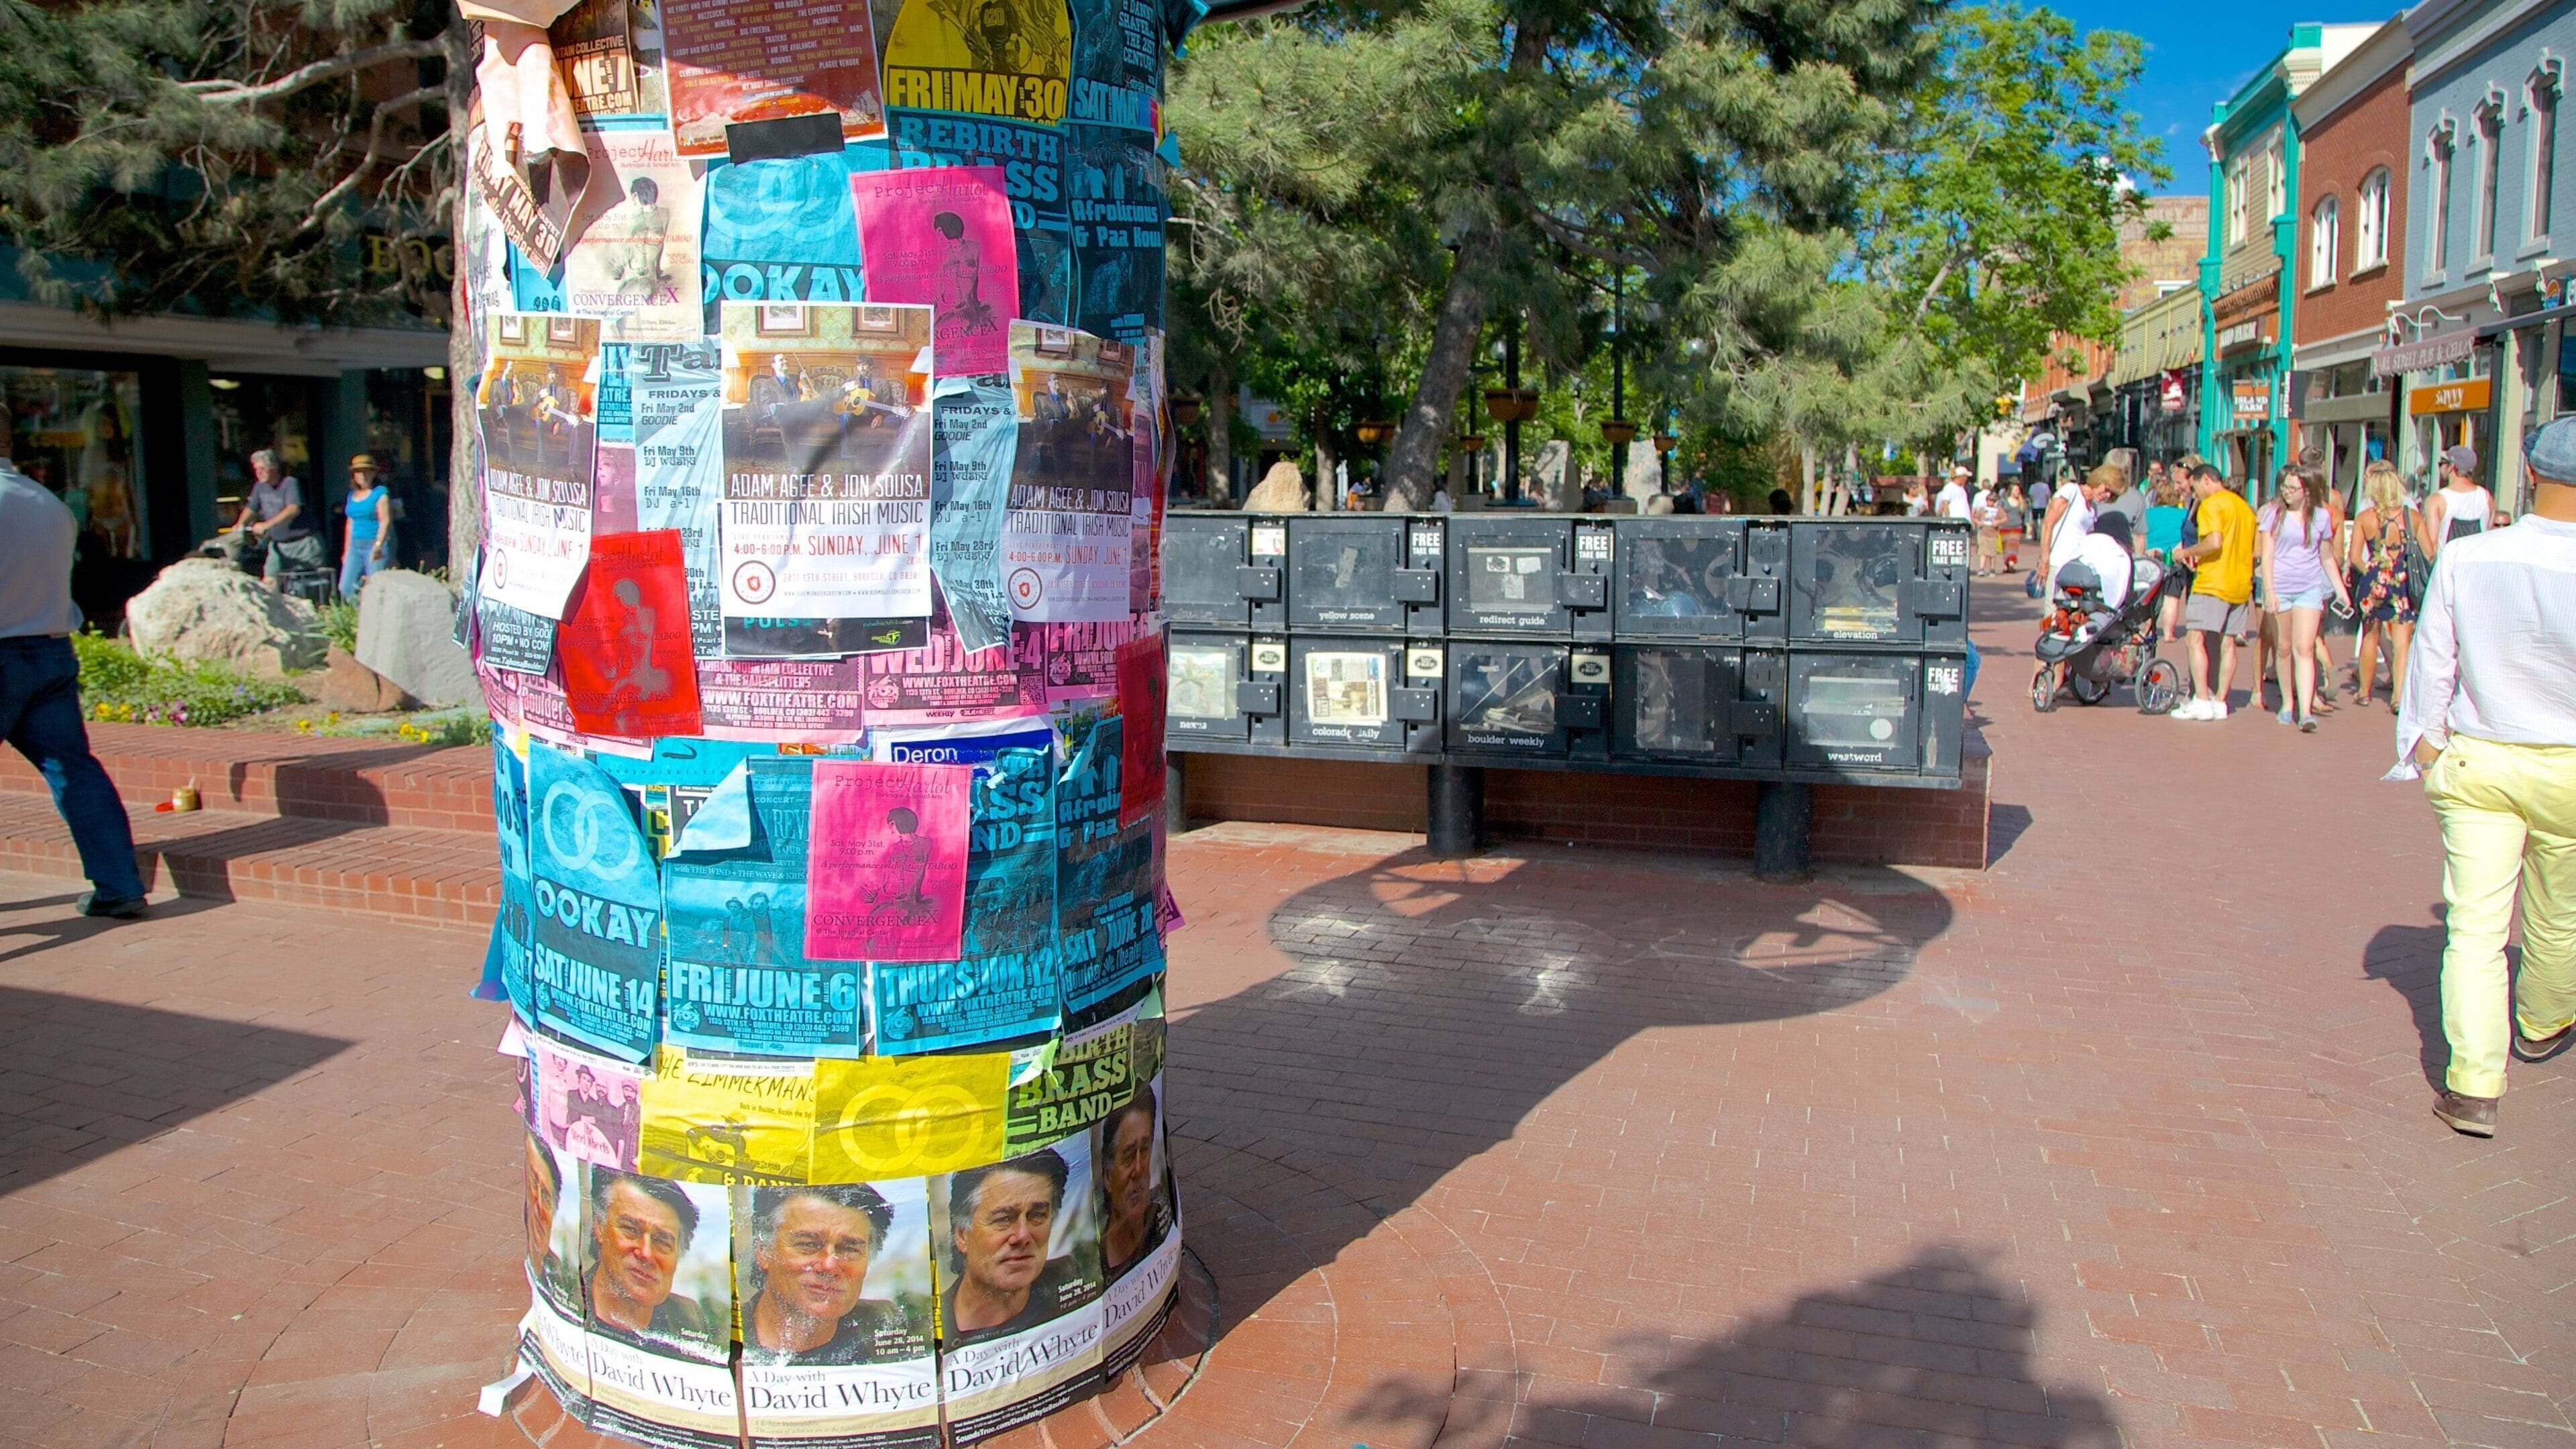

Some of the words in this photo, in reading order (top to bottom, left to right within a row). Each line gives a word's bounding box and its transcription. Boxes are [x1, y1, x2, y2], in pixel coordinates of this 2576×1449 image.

[808, 4, 843, 15] EXPENDABLES
[714, 18, 736, 28] MINERAL
[780, 75, 804, 85] ELECTRIC
[889, 68, 942, 110] FRI
[951, 70, 1019, 116] MAY
[1024, 76, 1064, 119] 30
[898, 116, 1059, 164] REBIRTH
[1072, 200, 1159, 223] Afrolicious
[500, 208, 532, 257] Theater
[664, 235, 693, 244] TABOO
[1096, 226, 1129, 248] Paa
[900, 250, 918, 260] May
[2393, 351, 2416, 366] STREET
[2419, 346, 2434, 364] PUB
[2436, 344, 2443, 362] &
[649, 390, 708, 398] FRIDAYS
[712, 390, 721, 398] &
[2234, 396, 2268, 405] ISLAND
[641, 403, 653, 413] Fri
[657, 404, 676, 416] May
[679, 402, 695, 413] 2nd
[941, 407, 1000, 415] FRIDAYS
[1004, 407, 1012, 415] &
[2238, 404, 2263, 412] FARM
[641, 415, 678, 425] GOODIE
[934, 419, 947, 429] Fri
[950, 419, 969, 432] May
[971, 419, 987, 429] 2nd
[934, 431, 972, 441] GOODIE
[644, 446, 655, 456] Fri
[658, 446, 676, 459] May
[679, 446, 695, 456] 9th
[934, 462, 947, 471] Fri
[949, 462, 969, 474] May
[971, 461, 986, 471] 9th
[644, 486, 655, 496] Fri
[658, 486, 677, 499] May
[681, 486, 701, 496] 16th
[731, 474, 773, 498] ADAM
[780, 474, 814, 498] AGEE
[820, 474, 834, 498] &
[840, 474, 869, 498] JON
[875, 474, 923, 498] SOUSA
[1010, 484, 1045, 508] ADAM
[1049, 487, 1073, 509] AGEE
[1075, 488, 1083, 510] &
[1087, 489, 1104, 511] JON
[1107, 490, 1129, 513] SOUSA
[731, 502, 824, 525] TRADITIONAL
[833, 502, 870, 525] IRISH
[877, 502, 923, 525] MUSIC
[935, 501, 947, 511] Fri
[951, 501, 969, 513] May
[973, 500, 991, 511] 16th
[1009, 511, 1077, 535] TRADITIONAL
[1082, 515, 1104, 537] IRISH
[1107, 516, 1129, 537] MUSIC
[682, 527, 703, 537] 23rd
[1412, 532, 1440, 547] FREE
[936, 542, 948, 552] Fri
[951, 541, 971, 554] May
[973, 541, 994, 551] 23rd
[1578, 535, 1608, 550] FREE
[1932, 539, 1964, 555] FREE
[1412, 547, 1427, 555] TAKE
[1428, 547, 1440, 555] ONE
[1579, 551, 1594, 559] TAKE
[1595, 551, 1608, 559] ONE
[1932, 556, 1948, 565] TAKE
[1950, 556, 1964, 565] ONE
[1319, 611, 1348, 621] yellow
[1349, 611, 1375, 621] scene
[1479, 615, 1516, 625] redirect
[1519, 616, 1545, 626] guide
[1833, 630, 1878, 639] elevation
[714, 674, 722, 685] &
[724, 674, 742, 686] THE
[742, 675, 811, 688] RAILSPLITTERS
[902, 674, 1018, 689] WWW.FOXTHEATRE.COM
[1928, 667, 1959, 683] FREE
[702, 690, 857, 709] WWW.FOXTHEATRE.COM
[1468, 735, 1505, 745] boulder
[1509, 737, 1545, 749] weekly
[894, 746, 958, 764] Deron
[835, 775, 904, 793] Project
[896, 771, 951, 794] Harlot
[755, 796, 795, 804] CONCERT
[775, 843, 802, 855] TOUR
[535, 879, 658, 949] OOKAY
[1065, 928, 1097, 965] SAT
[535, 942, 566, 989] SAT
[568, 958, 623, 1011] JUNE
[625, 978, 655, 1020] 14
[880, 960, 976, 1007] THURS
[977, 953, 1025, 996] JUN
[1030, 947, 1055, 987] 12
[672, 961, 724, 1003] FRI
[733, 969, 822, 1010] JUNE
[830, 972, 856, 1012] 6
[916, 984, 1055, 1018] WWW.FOXTHEATRE.COM
[551, 985, 652, 1034] WWW.FOXTHEATRE.COM
[704, 1004, 853, 1025] WWW.FOXTHEATRE.COM
[1016, 1051, 1128, 1109] BRASS
[1038, 1092, 1114, 1135] BAND
[1058, 1277, 1083, 1294] Saturday
[681, 1326, 709, 1342] Saturday
[874, 1327, 908, 1338] Saturday
[874, 1337, 893, 1347] June
[895, 1336, 906, 1346] 28,
[907, 1335, 924, 1344] 2014
[949, 1351, 1022, 1393] David
[1028, 1322, 1098, 1368] Whyte
[592, 1352, 646, 1391] David
[651, 1371, 731, 1411] Whyte
[749, 1371, 760, 1383] A
[765, 1371, 791, 1386] Day
[796, 1370, 826, 1383] with
[749, 1385, 828, 1409] David
[835, 1380, 931, 1410] Whyte
[955, 1395, 1071, 1444] SoundsTrue.com/DavidWhyteBoulder
